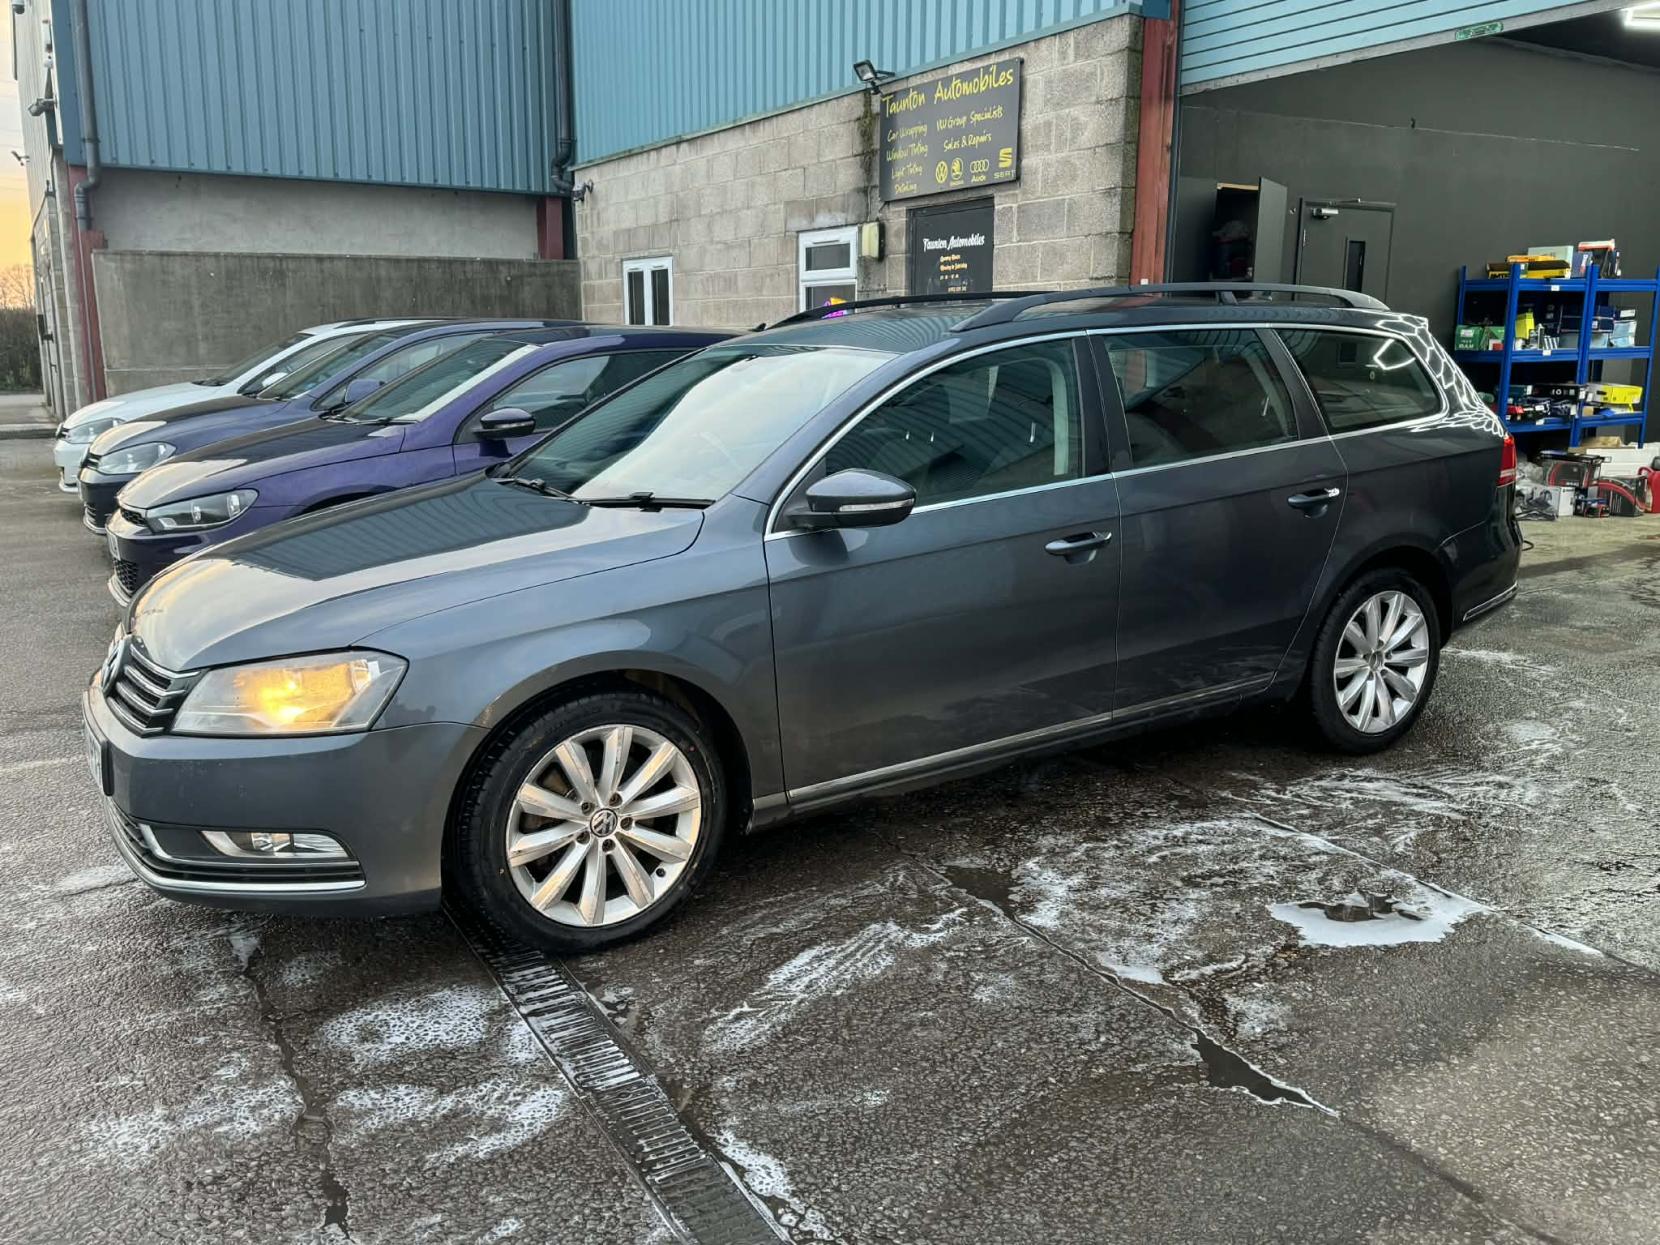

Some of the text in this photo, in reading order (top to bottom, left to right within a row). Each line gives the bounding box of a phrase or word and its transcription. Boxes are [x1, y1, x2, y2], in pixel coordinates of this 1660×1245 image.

[882, 65, 1013, 117] Taunton Automobiles
[968, 131, 992, 149] Repairs
[971, 175, 987, 183] Audi
[922, 233, 985, 252] Taunton Automobiles
